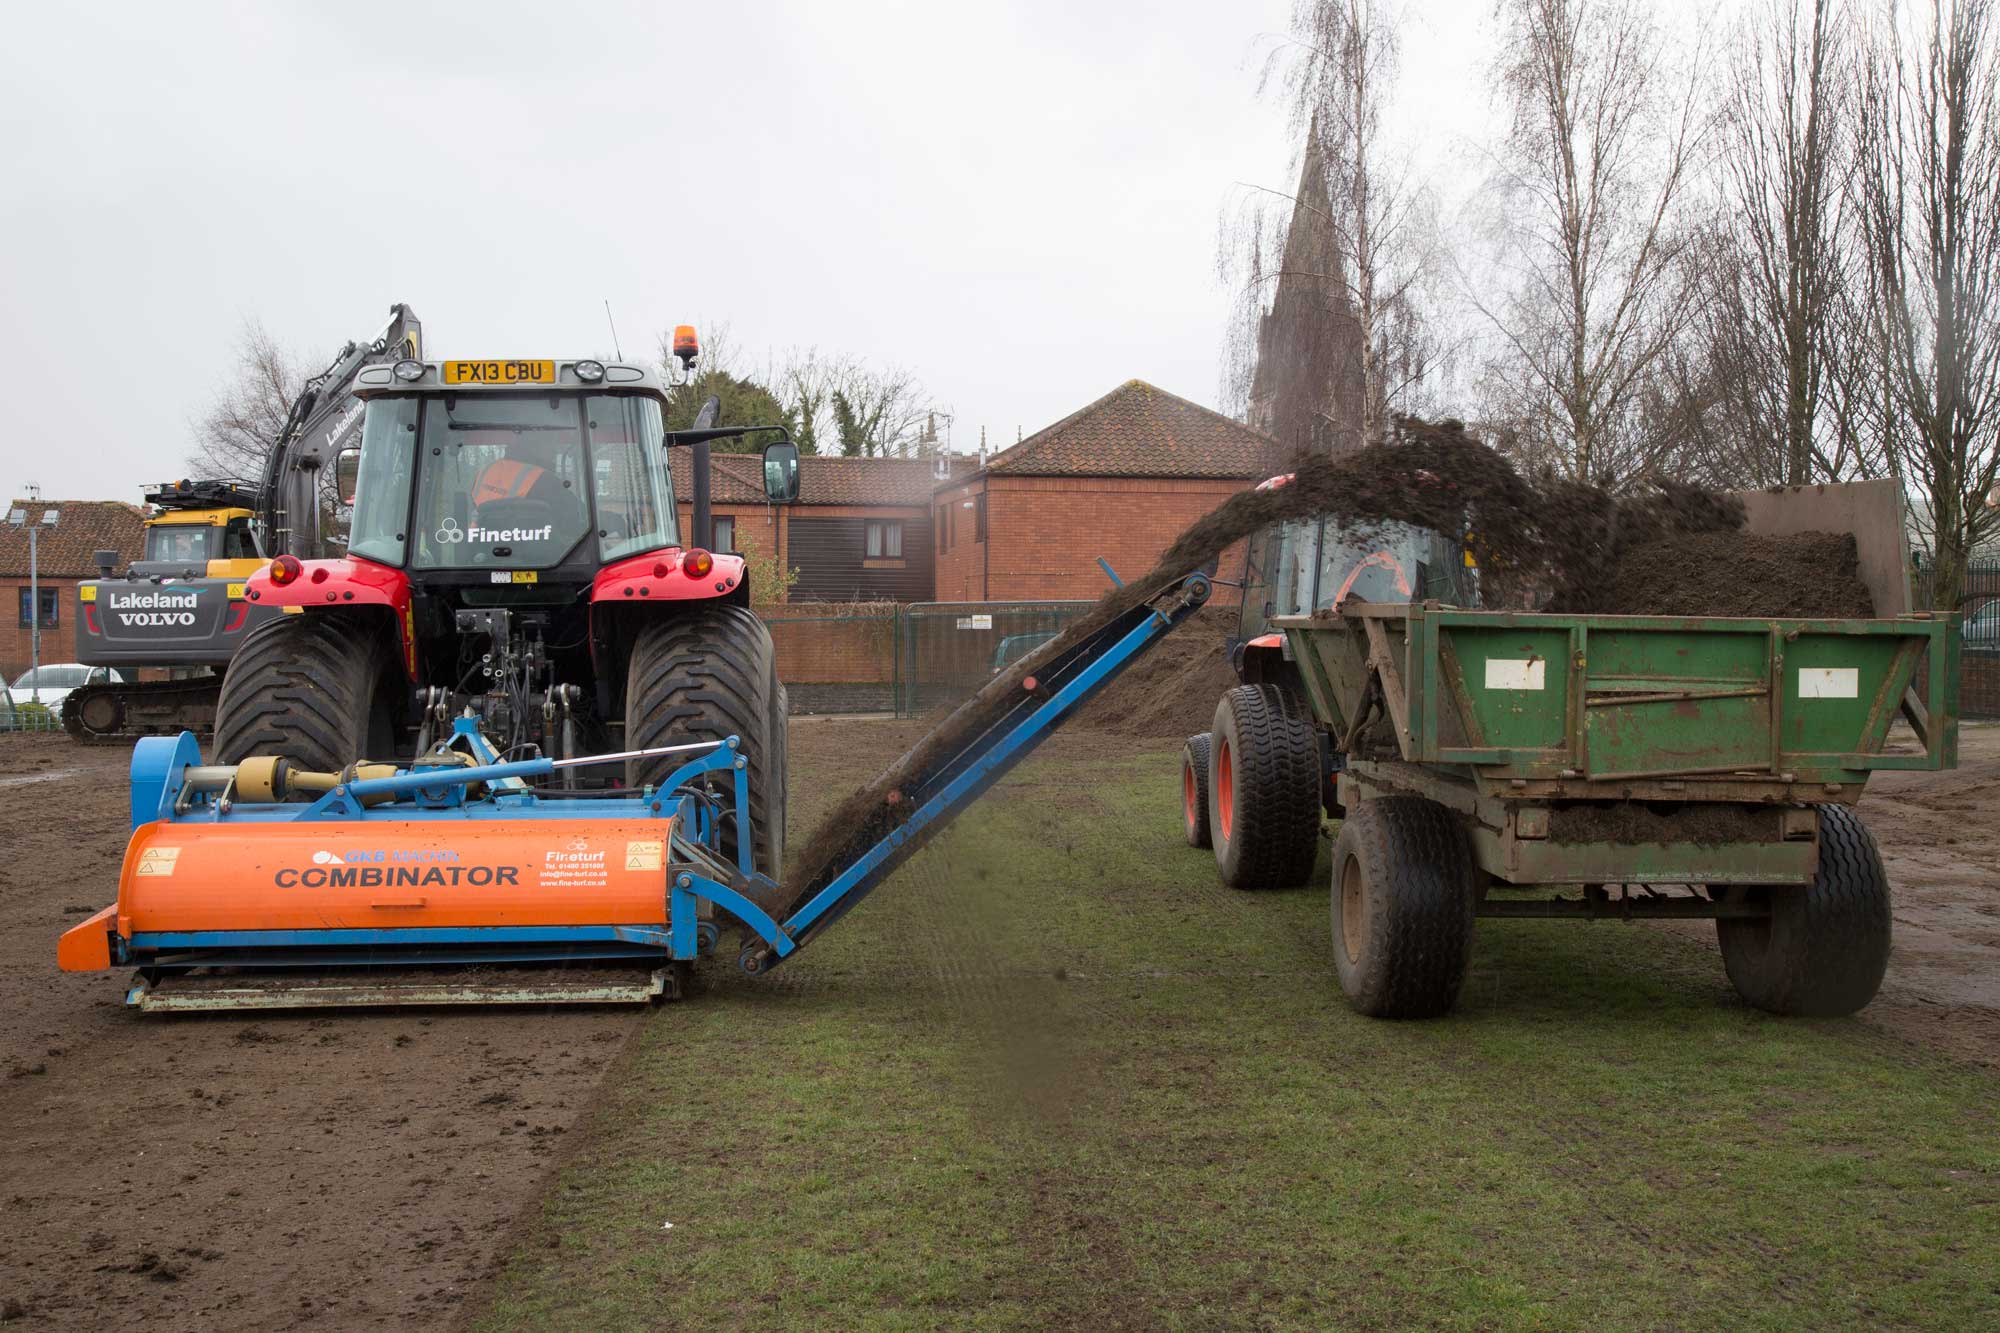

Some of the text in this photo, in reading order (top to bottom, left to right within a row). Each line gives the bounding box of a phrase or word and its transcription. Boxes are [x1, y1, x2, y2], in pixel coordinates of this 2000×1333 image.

[457, 363, 542, 380] FX13 CBU
[326, 399, 365, 447] Lakeland
[467, 525, 552, 543] Fineturf
[110, 592, 198, 609] Lakeland
[118, 612, 195, 626] VOLVO
[345, 850, 385, 862] GKB
[274, 866, 519, 888] COMBINATOR
[540, 879, 607, 887] www.fine-turf.co.uk
